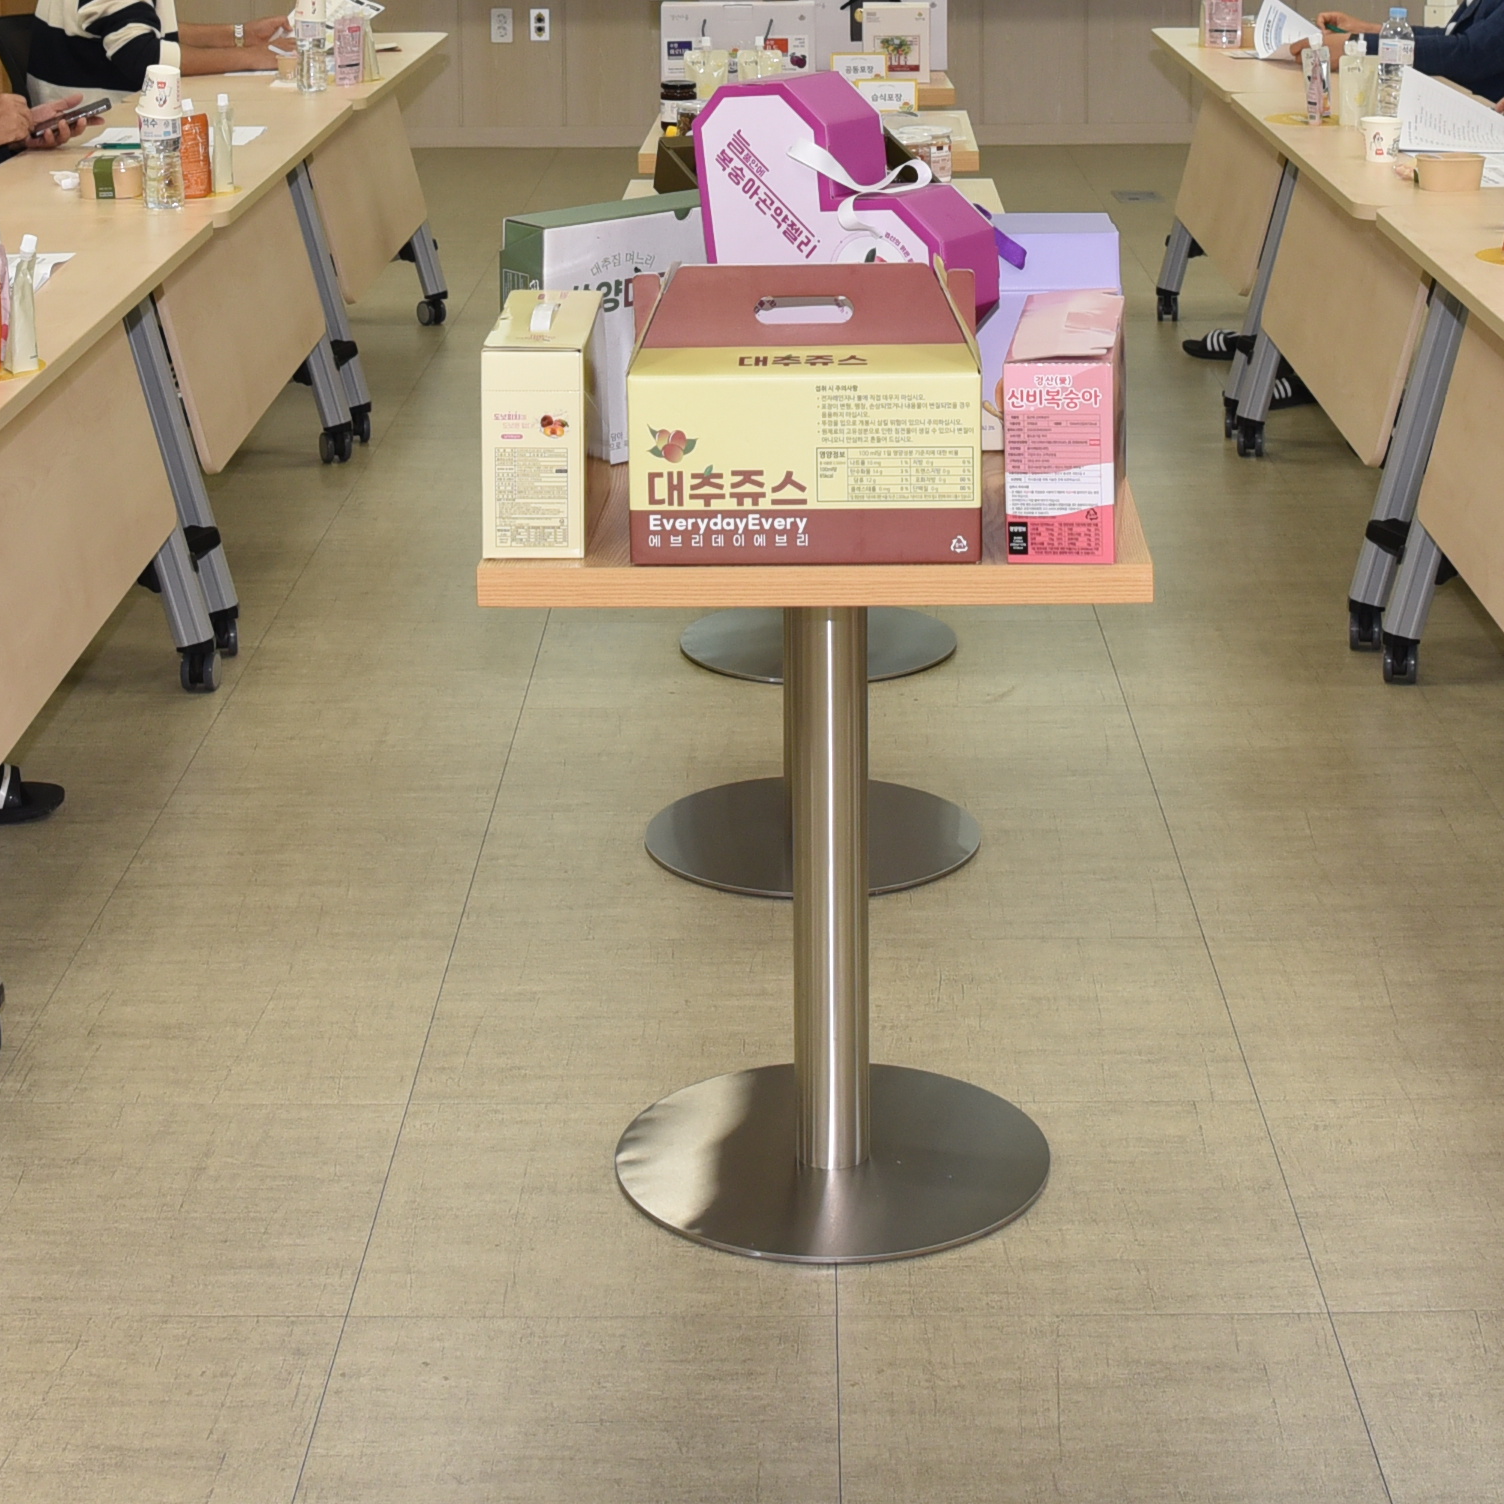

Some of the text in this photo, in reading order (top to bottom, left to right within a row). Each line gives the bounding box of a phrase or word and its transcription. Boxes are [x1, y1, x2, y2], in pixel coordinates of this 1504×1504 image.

[845, 65, 874, 74] 공동포장
[871, 93, 902, 102] 습식포장
[715, 147, 820, 259] 복숭아곤약젤리
[590, 250, 656, 276] 대추집 며느리
[738, 354, 868, 367] 대추쥬스
[1007, 388, 1102, 410] 신비복숭아
[647, 467, 808, 508] 대추쥬스
[649, 514, 808, 534] EverydayEvery
